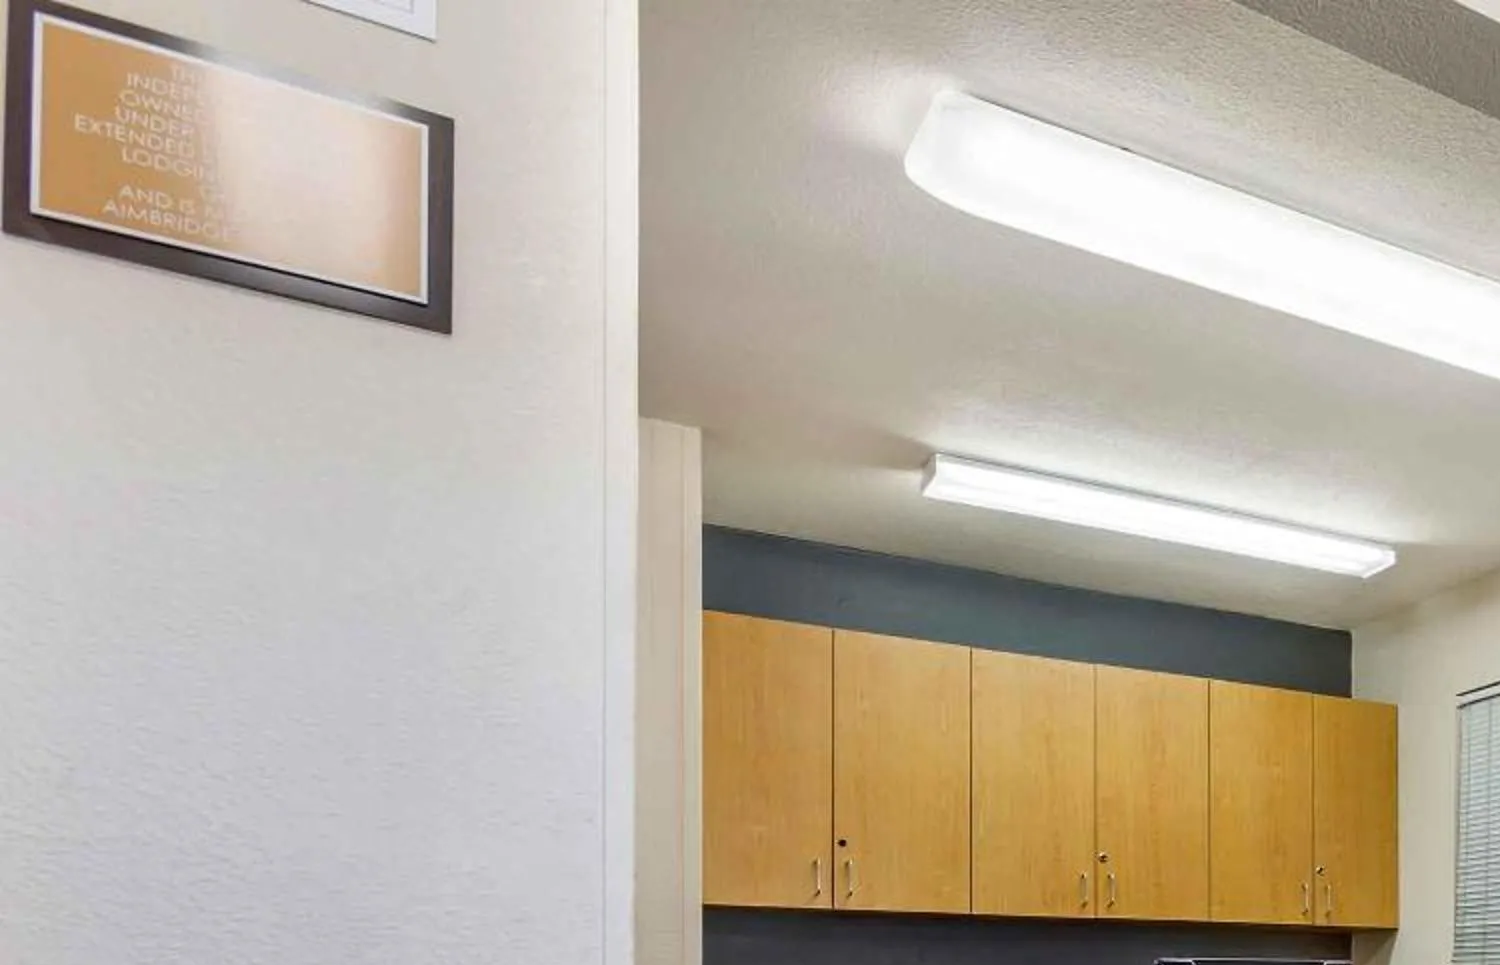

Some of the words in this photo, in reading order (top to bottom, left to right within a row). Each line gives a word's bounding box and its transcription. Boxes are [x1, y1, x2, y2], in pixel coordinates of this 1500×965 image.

[74, 112, 196, 160] EXTENDED
[115, 105, 195, 137] UNDER
[122, 147, 216, 184] LODGIN
[119, 184, 172, 209] AND
